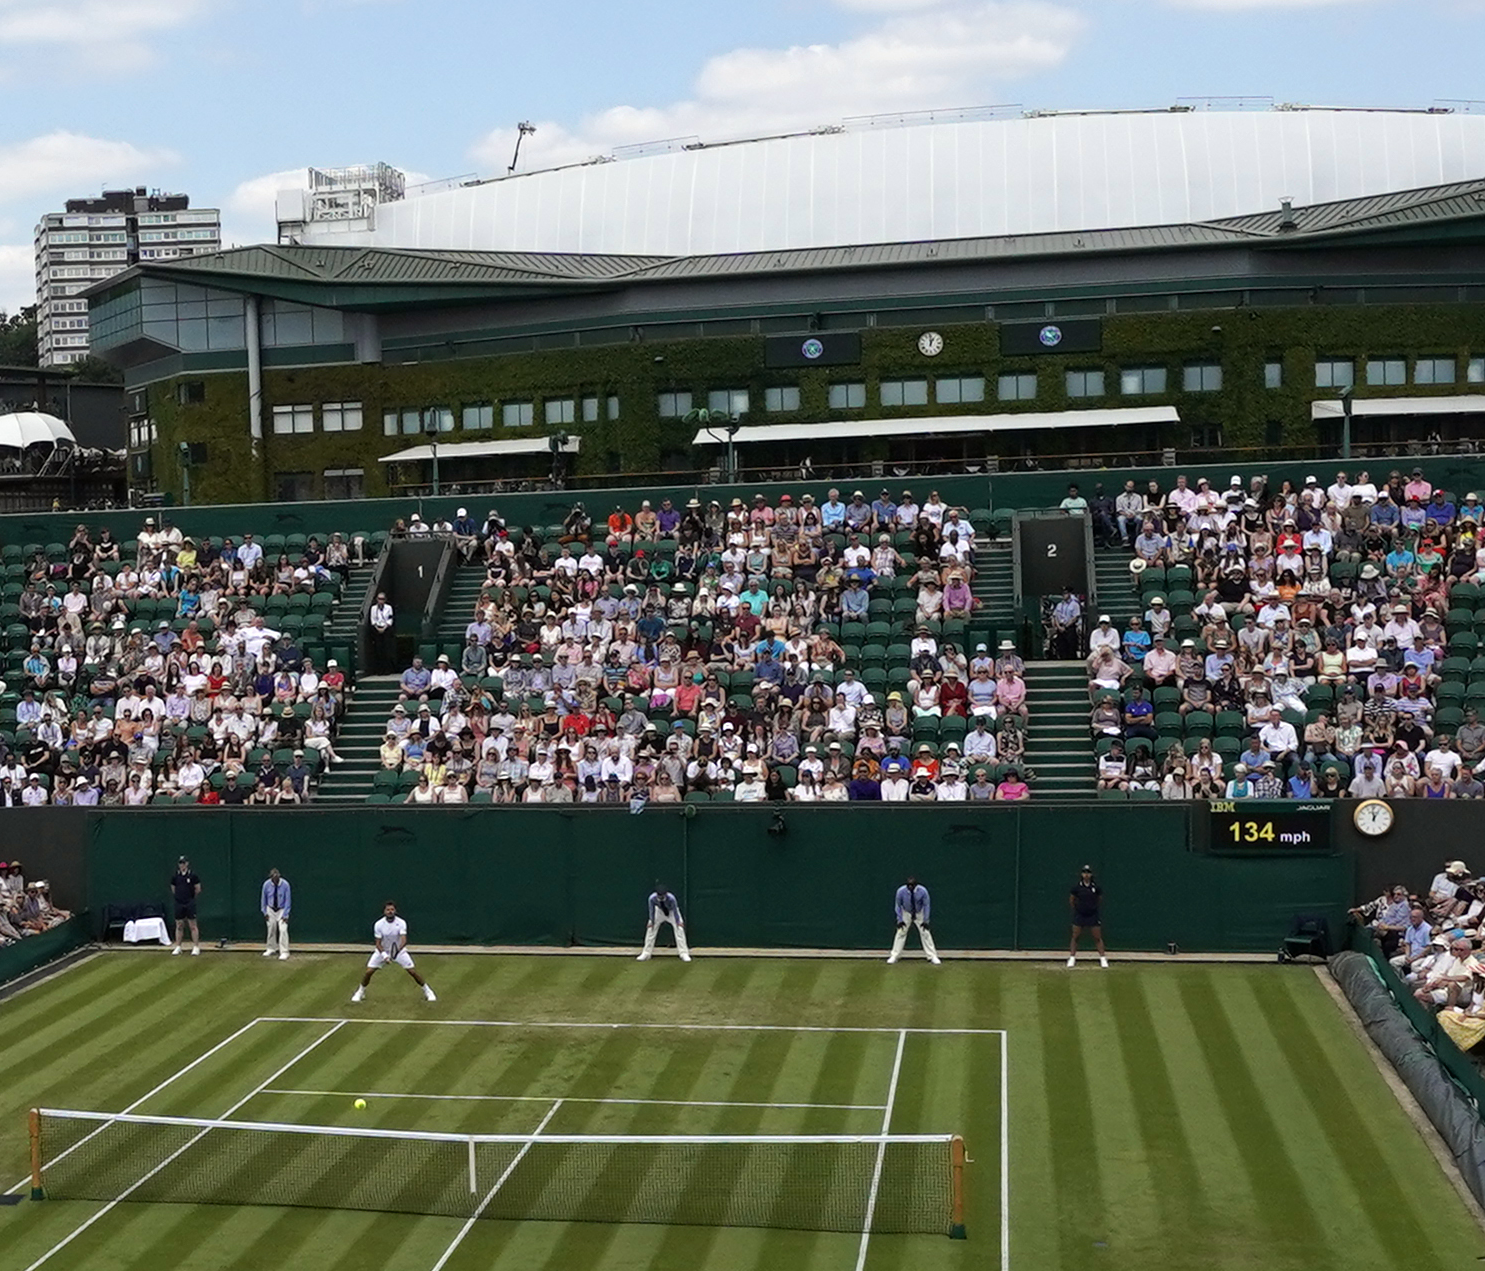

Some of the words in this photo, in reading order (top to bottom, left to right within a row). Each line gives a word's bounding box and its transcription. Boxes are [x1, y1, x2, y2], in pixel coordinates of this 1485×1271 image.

[1047, 543, 1057, 557] 2
[417, 565, 423, 578] 1
[1210, 802, 1235, 812] IBM
[1229, 821, 1275, 842] 134
[1280, 831, 1311, 845] mph
